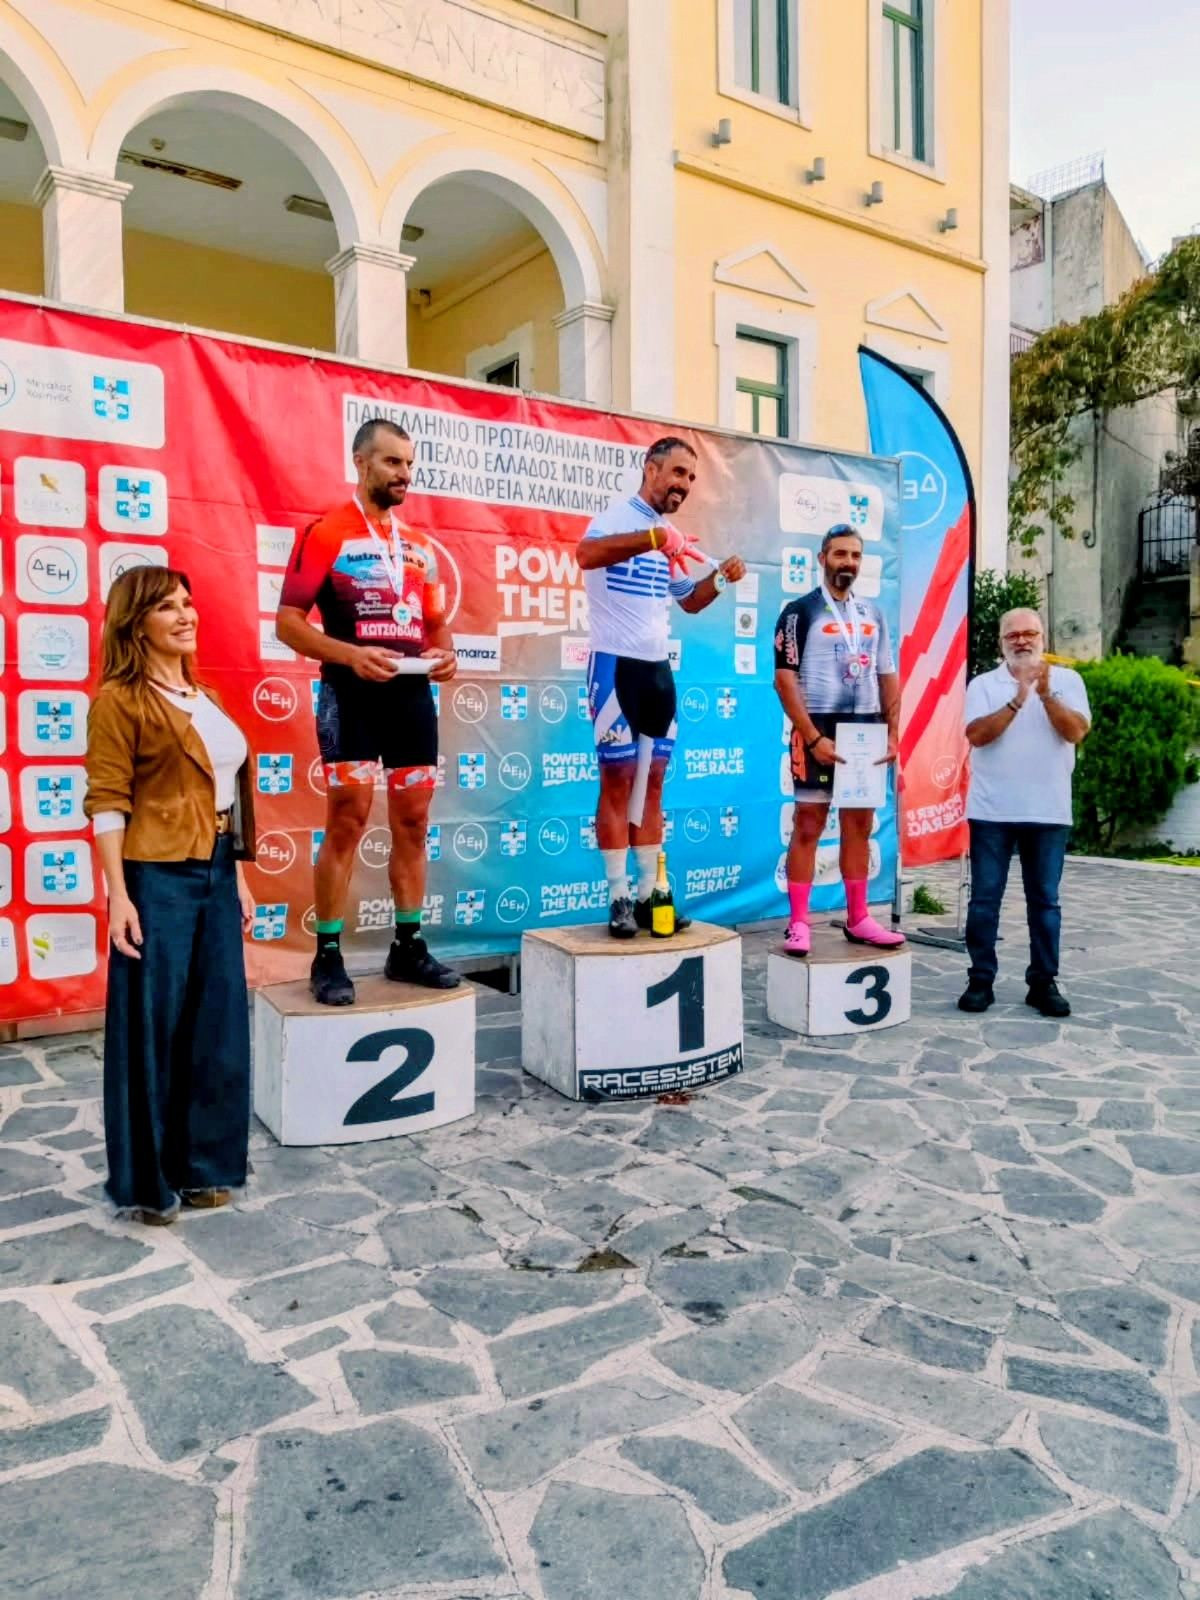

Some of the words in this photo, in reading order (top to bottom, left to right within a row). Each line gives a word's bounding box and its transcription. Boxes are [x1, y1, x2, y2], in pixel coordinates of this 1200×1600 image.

[475, 424, 591, 462] ΠΡΩΤΑΘΛΗΜΑ
[594, 444, 625, 468] MTB
[629, 449, 646, 471] XC
[412, 440, 478, 470] ΥΠΕΛΛΟ
[484, 452, 558, 482] ΕΛΛΑΔΟΣ
[562, 463, 594, 487] MTB
[597, 470, 624, 492] XCC
[528, 483, 611, 513] ΧΑΛΚΙΔΙΚΗΣ
[31, 558, 70, 583] ΔΕΗ
[495, 544, 586, 585] POW
[496, 583, 566, 620] THE
[454, 648, 498, 660] maraz
[258, 688, 292, 710] ΔΕΗ
[456, 694, 483, 713] ΔΕΗ
[542, 695, 563, 713] ΔΕΗ
[543, 752, 588, 767] POWER
[685, 749, 726, 761] POWER
[729, 747, 744, 759] UP
[502, 762, 527, 779] ΔΕΗ
[543, 767, 566, 780] THE
[567, 765, 601, 782] RAC
[686, 761, 708, 773] THE
[708, 759, 744, 775] RACE
[686, 816, 707, 832] ΔΕΗ
[457, 833, 483, 851] ΔΕΗ
[542, 829, 565, 845] ΔΕΗ
[257, 842, 290, 861] ΔΕΗ
[686, 866, 725, 882] POWER
[727, 865, 742, 876] UP
[541, 882, 589, 898] POWER
[591, 880, 609, 893] UP
[685, 880, 706, 893] THE
[706, 876, 740, 893] RACE
[358, 897, 396, 914] POW
[422, 895, 444, 910] UP
[501, 897, 525, 913] ΔΕΗ
[541, 896, 566, 911] THE
[567, 892, 608, 911] RACE
[357, 911, 390, 926] THE
[646, 954, 705, 1053] 1
[843, 964, 893, 1026] 3
[342, 1027, 436, 1126] 2
[583, 1047, 741, 1089] RACESYSTEM
